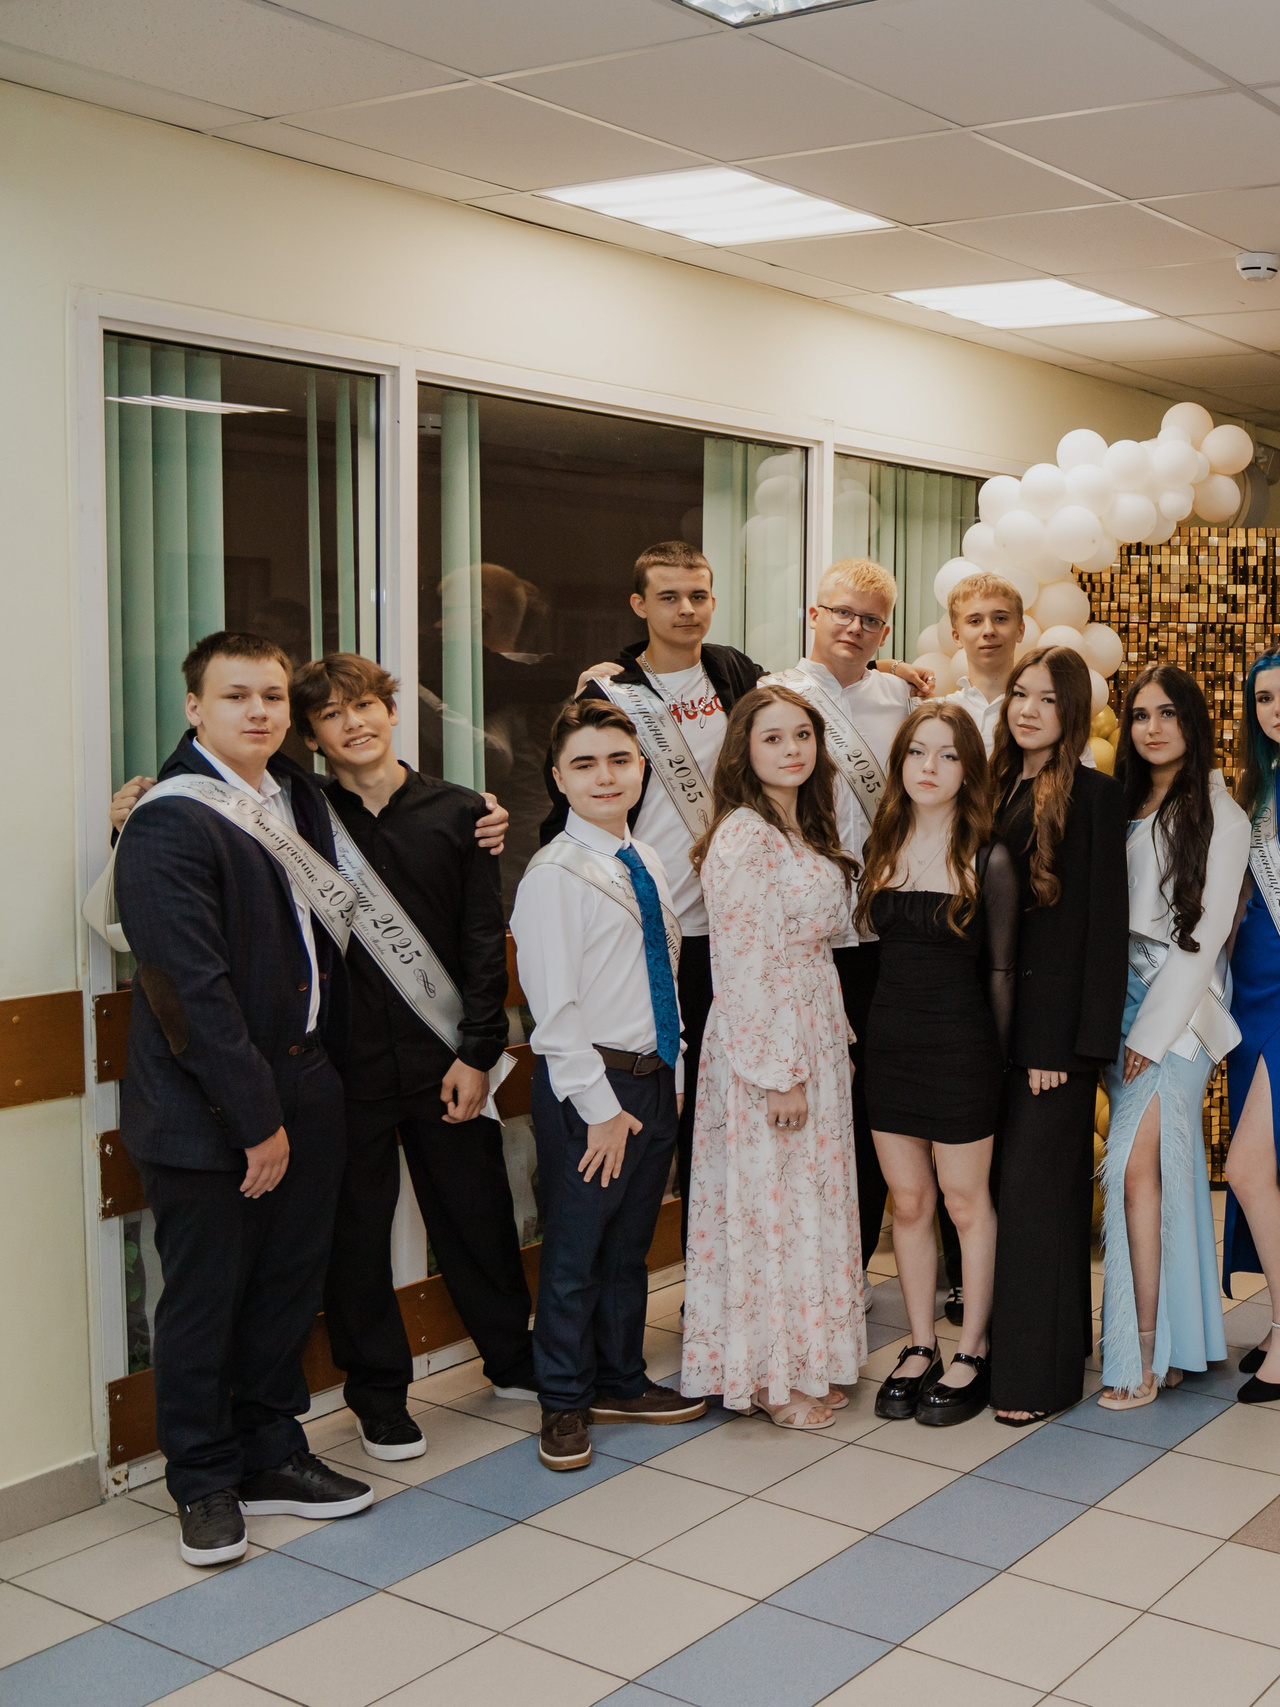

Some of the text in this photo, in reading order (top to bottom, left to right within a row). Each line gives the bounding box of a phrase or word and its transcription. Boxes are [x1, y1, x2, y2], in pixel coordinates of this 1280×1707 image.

[666, 754, 704, 803] 2025
[845, 749, 881, 794] 2025
[235, 799, 318, 884] Выпускник
[370, 913, 422, 964] 2025
